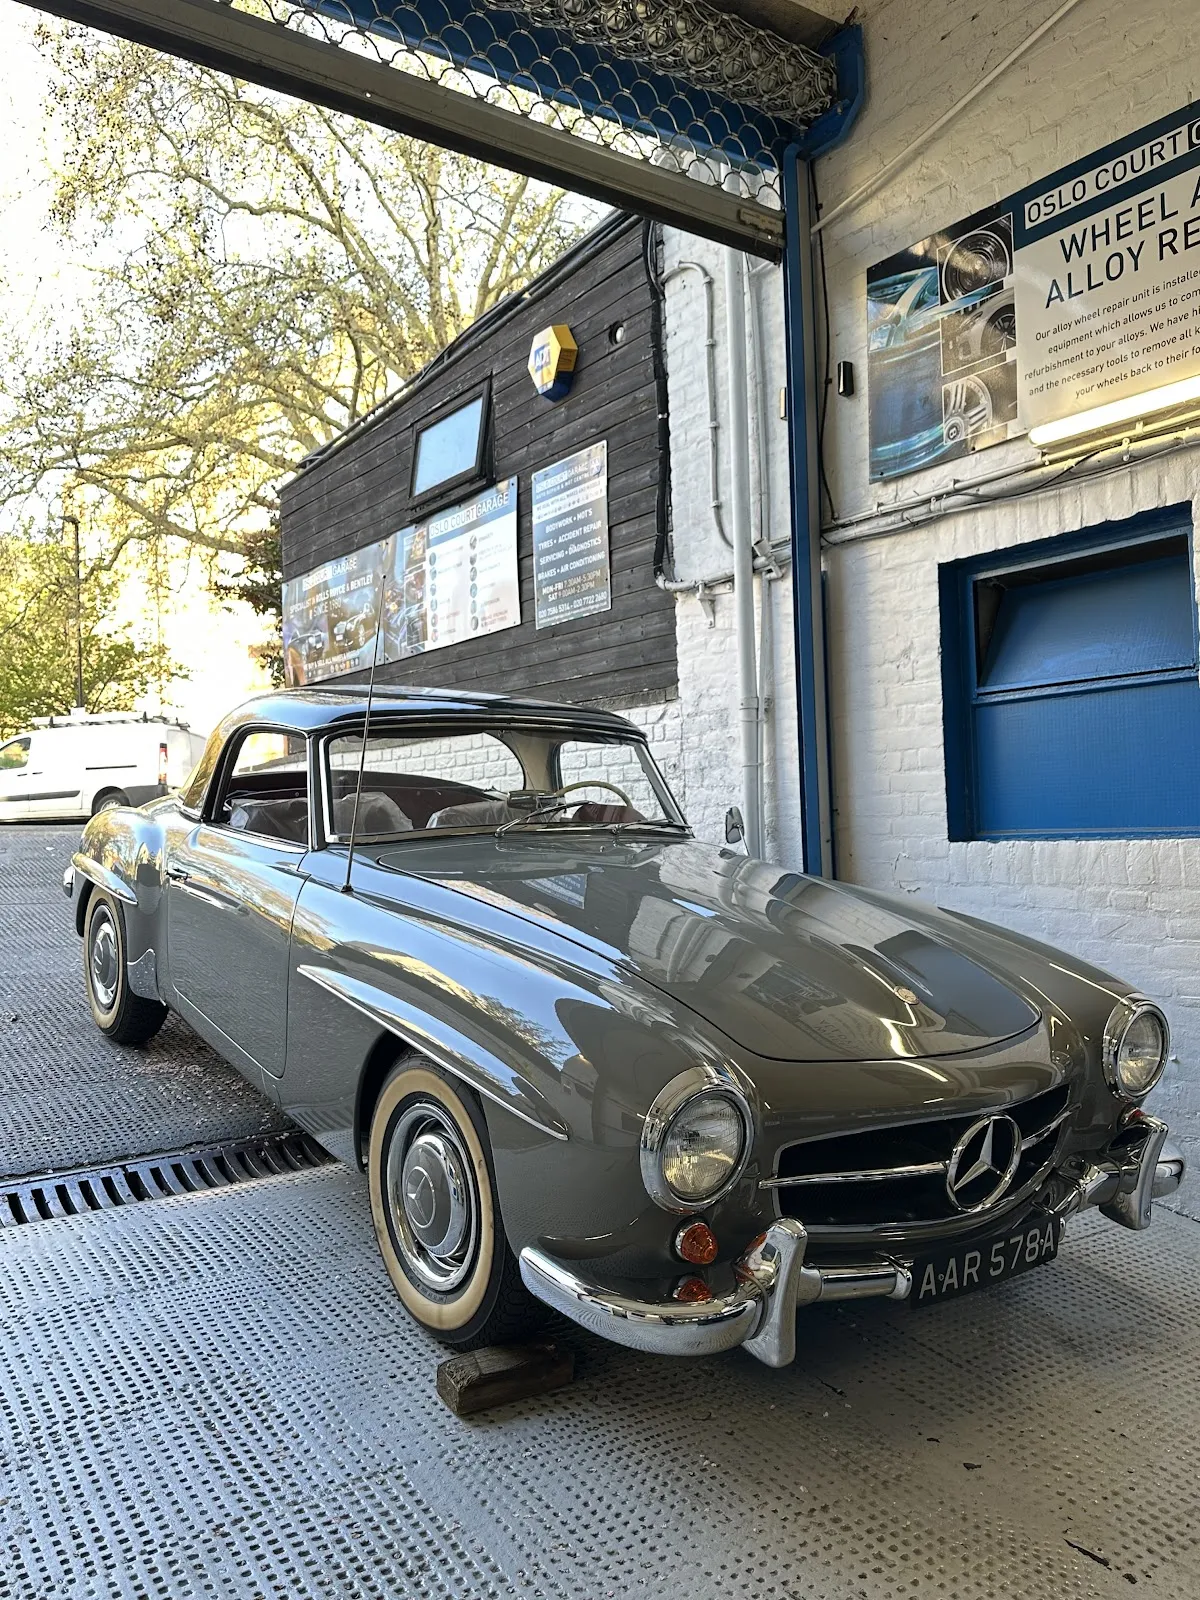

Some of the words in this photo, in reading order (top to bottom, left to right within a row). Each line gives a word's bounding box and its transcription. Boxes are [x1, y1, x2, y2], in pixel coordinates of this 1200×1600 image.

[1028, 180, 1087, 223] OSLO
[1095, 131, 1182, 190] COURT
[1060, 192, 1178, 264] WHEEL
[1045, 240, 1145, 309] ALLOY
[1159, 215, 1200, 261] RE
[1035, 330, 1051, 341] Our
[1052, 321, 1072, 335] alloy
[1074, 308, 1100, 326] wheel
[1103, 298, 1130, 315] repair
[1132, 289, 1150, 303] unit
[1152, 285, 1161, 295] is
[1163, 270, 1200, 291] installe
[1048, 331, 1093, 354] equipment
[1095, 320, 1121, 336] which
[1123, 307, 1153, 325] allows
[1155, 302, 1166, 312] us
[1169, 297, 1178, 307] to
[1024, 352, 1084, 381] refurbishment
[1086, 349, 1095, 358] to
[1096, 341, 1116, 356] your
[1118, 329, 1148, 346] alloys.
[1149, 321, 1164, 333] We
[1167, 312, 1189, 327] have
[1029, 383, 1044, 396] and
[1046, 379, 1060, 390] the
[1061, 363, 1105, 385] necessary
[1106, 354, 1129, 368] tools
[1131, 350, 1140, 359] to
[1142, 336, 1177, 355] remove
[1179, 329, 1192, 341] all
[1075, 384, 1095, 399] your
[1096, 372, 1129, 389] wheels
[1130, 363, 1152, 377] back
[1154, 360, 1164, 369] to
[1166, 349, 1190, 365] their
[430, 520, 449, 537] OSLO
[450, 507, 475, 528] COURT
[476, 491, 510, 517] GARAGE
[538, 539, 554, 551] TYRES
[558, 527, 583, 544] ACCIDENT
[583, 520, 602, 535] REPAIR
[545, 516, 573, 534] BODYWORK
[537, 567, 557, 581] BRAKES
[560, 563, 569, 574] AIR
[569, 550, 606, 570] CONDITIONING
[540, 549, 565, 566] SERVICING
[568, 536, 602, 555] DIAGNOSTICS
[313, 601, 329, 617] SINCE
[316, 589, 330, 602] ROLLS
[330, 584, 346, 598] ROYCE
[350, 573, 373, 591] BENTLEY
[548, 592, 558, 602] SAT
[919, 1251, 981, 1300] AAR
[989, 1222, 1054, 1277] 578A
